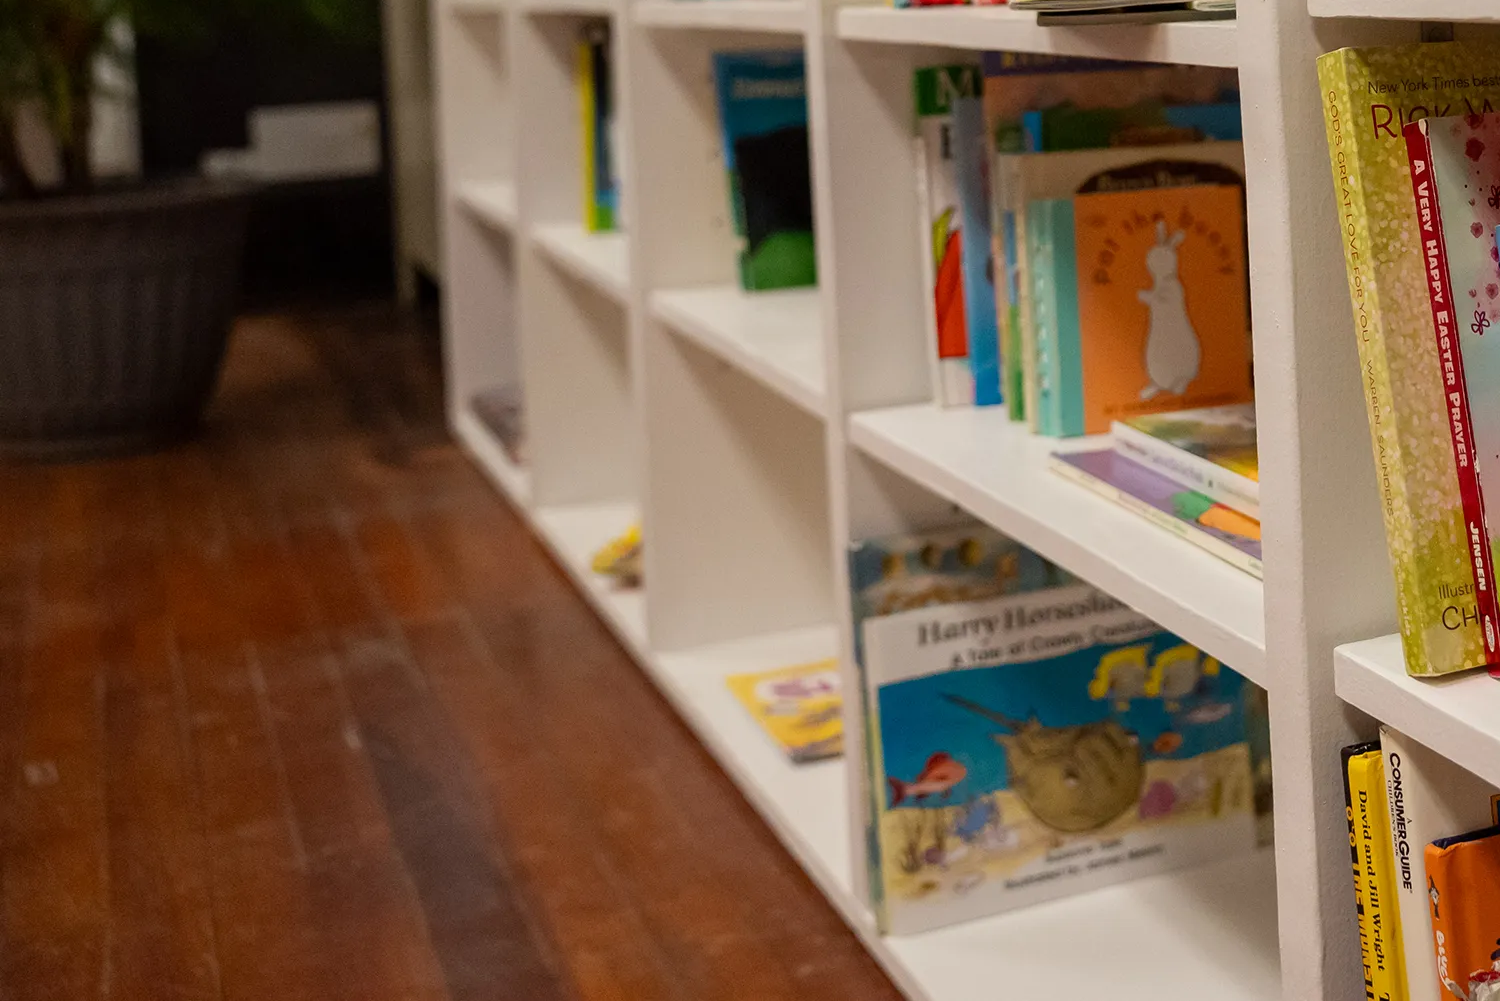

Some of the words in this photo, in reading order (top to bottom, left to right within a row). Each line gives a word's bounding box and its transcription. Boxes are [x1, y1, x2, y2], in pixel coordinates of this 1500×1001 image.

[1368, 81, 1398, 95] New
[1400, 78, 1429, 92] York
[1432, 75, 1470, 91] Times
[1328, 90, 1343, 147] GOD'S
[1337, 151, 1352, 209] GREAT
[1413, 160, 1425, 175] A
[1416, 181, 1433, 232] VERY
[1347, 213, 1360, 263] LOVE
[1353, 268, 1363, 299] FOR
[1425, 239, 1444, 304] HAPPY
[1359, 301, 1370, 343] YOU
[1436, 310, 1457, 387] EASTER
[1366, 359, 1381, 426] WARREN
[1376, 434, 1394, 517] SAUNDERS
[1449, 391, 1468, 468] PRAYER
[1469, 521, 1487, 591] JENSEN
[1438, 583, 1475, 600] Illustr
[917, 615, 998, 645] Harry
[1442, 605, 1480, 631] CH
[1358, 789, 1373, 840] David
[1364, 843, 1375, 871] and
[1369, 873, 1380, 908] Jill
[1372, 911, 1386, 971] Wright
